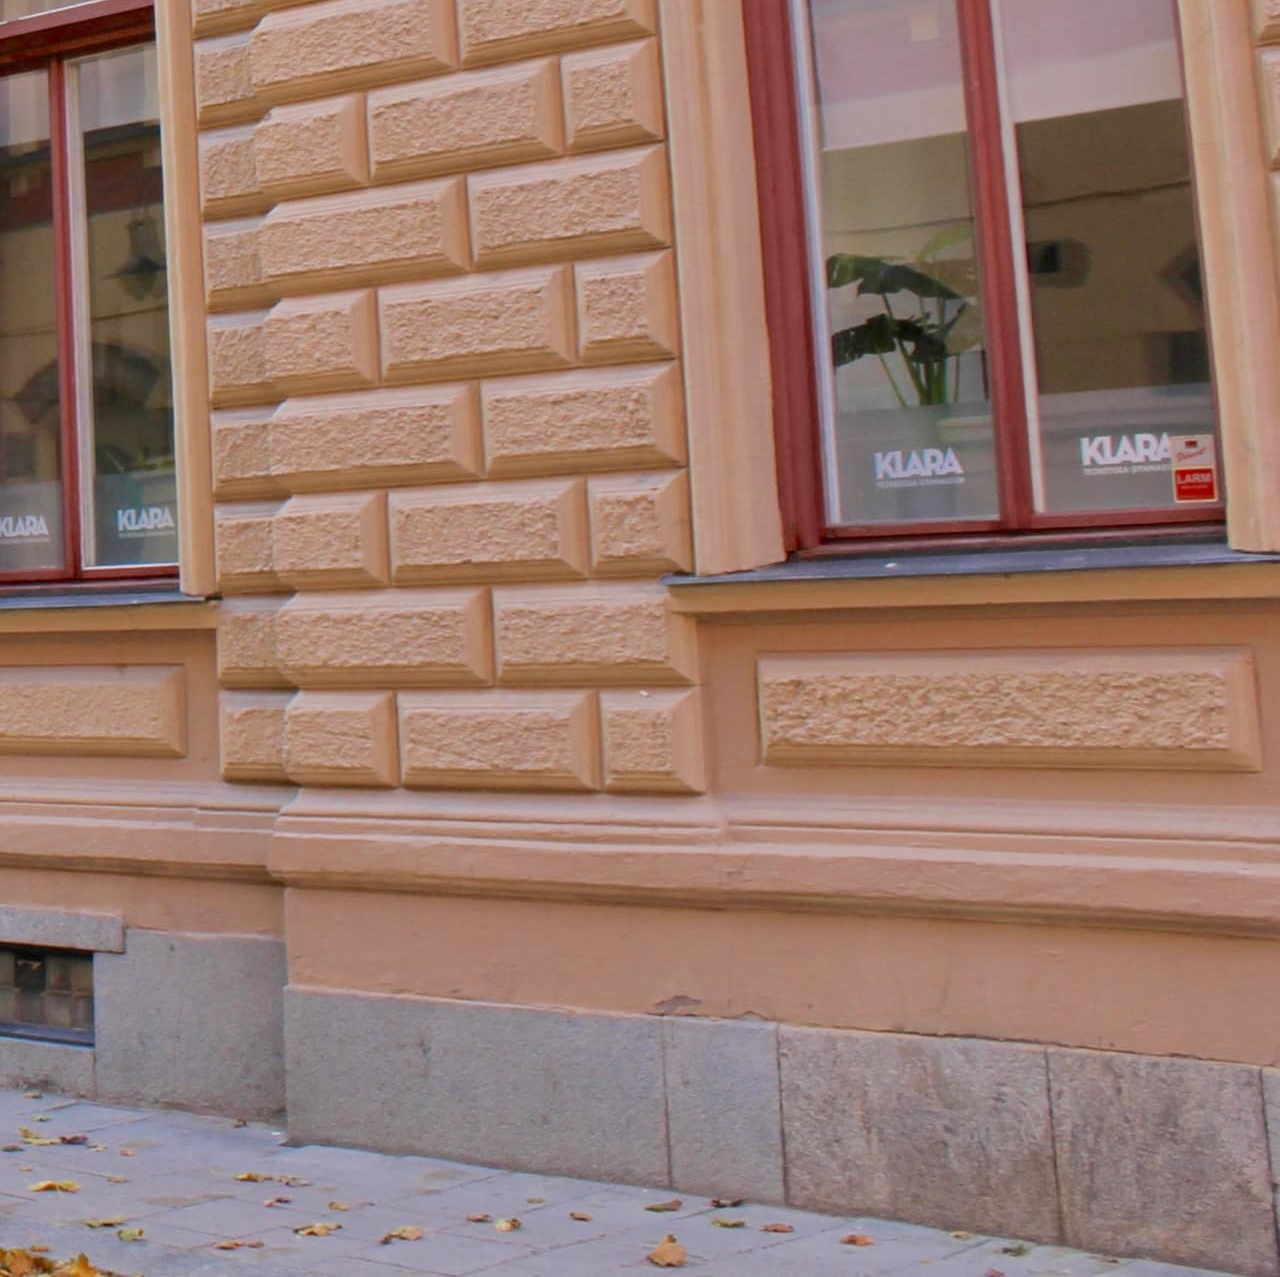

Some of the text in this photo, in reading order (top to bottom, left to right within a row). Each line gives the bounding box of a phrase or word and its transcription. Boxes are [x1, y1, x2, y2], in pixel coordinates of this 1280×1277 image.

[874, 447, 964, 479] KLARA
[1080, 432, 1172, 466] KLARA
[1176, 473, 1211, 484] LARM
[117, 507, 175, 531] KLARA
